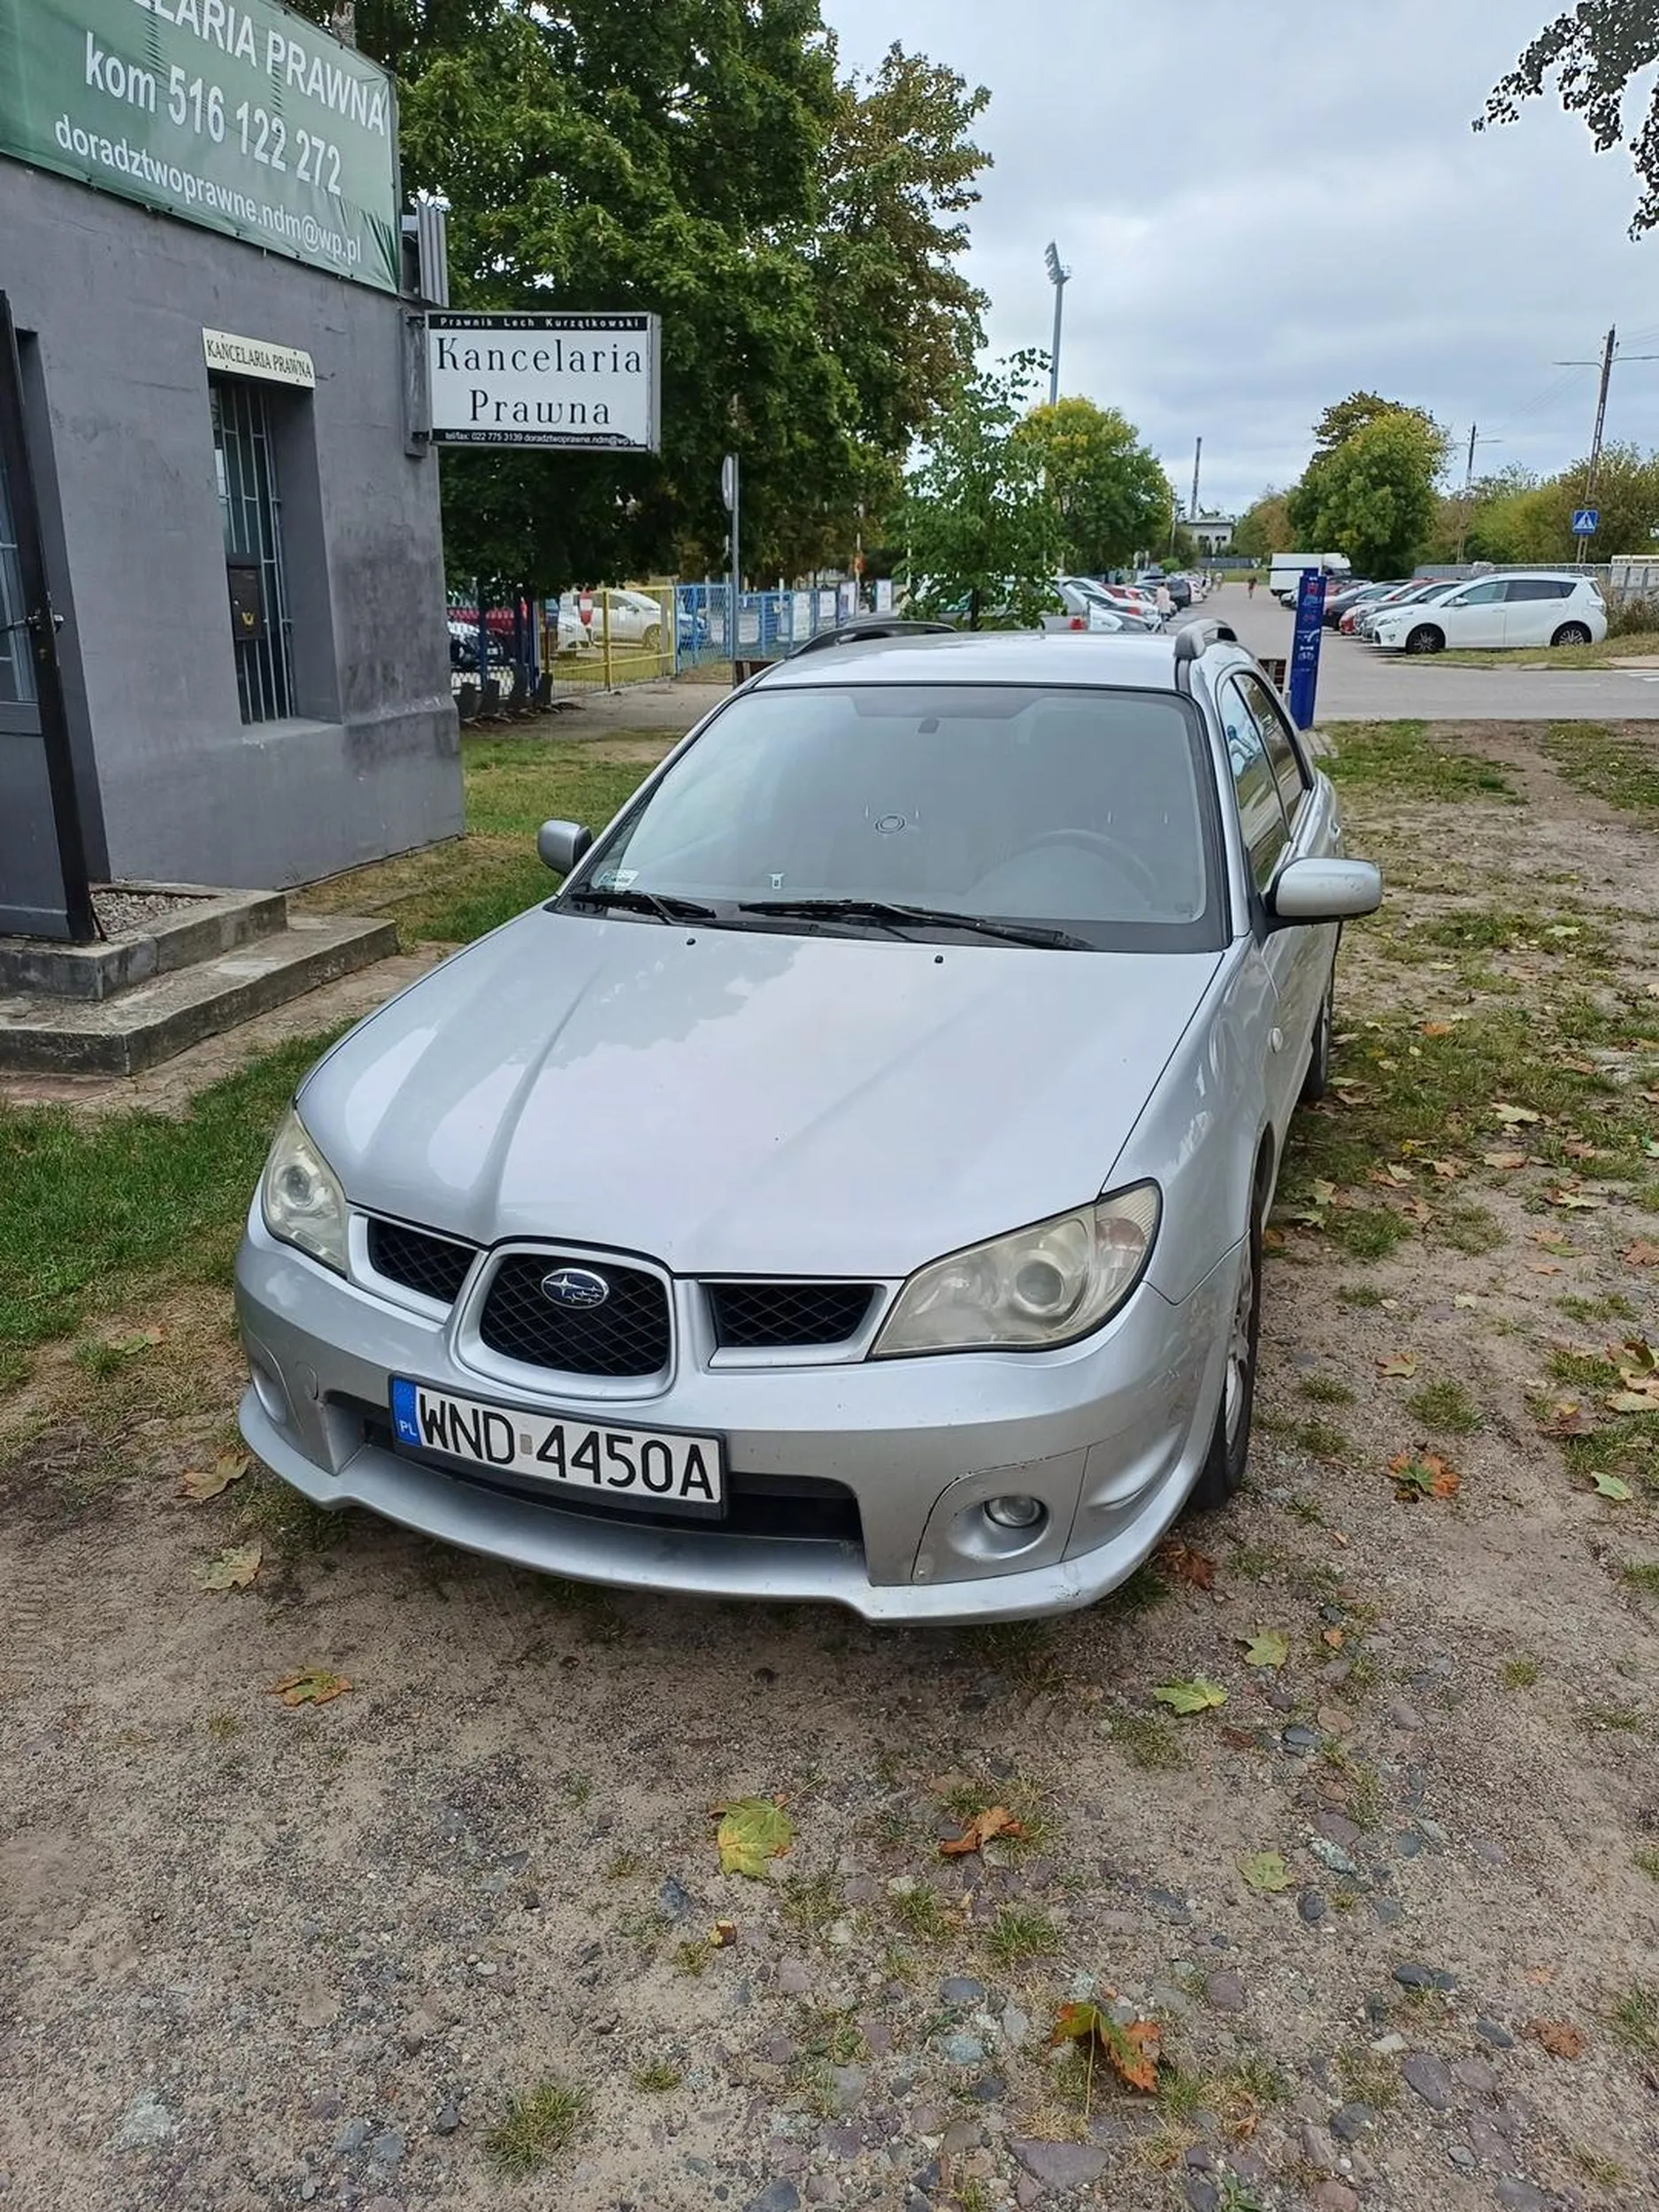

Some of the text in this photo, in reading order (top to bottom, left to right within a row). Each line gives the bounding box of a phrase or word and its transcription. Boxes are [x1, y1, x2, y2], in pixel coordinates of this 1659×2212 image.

[134, 0, 386, 136] LARIA PRAWNA
[85, 32, 342, 196] kom 516 122 272
[54, 114, 362, 264] doradztwoprawne.ndm@wp.pl
[440, 317, 493, 327] Prawnik
[503, 318, 535, 327] Lech
[206, 339, 313, 380] KANCELARIA PRAWNA
[436, 337, 642, 373] Kancelaria
[469, 389, 611, 425] Prawna
[398, 1419, 418, 1437] PL
[419, 1393, 714, 1500] WND 4450A
